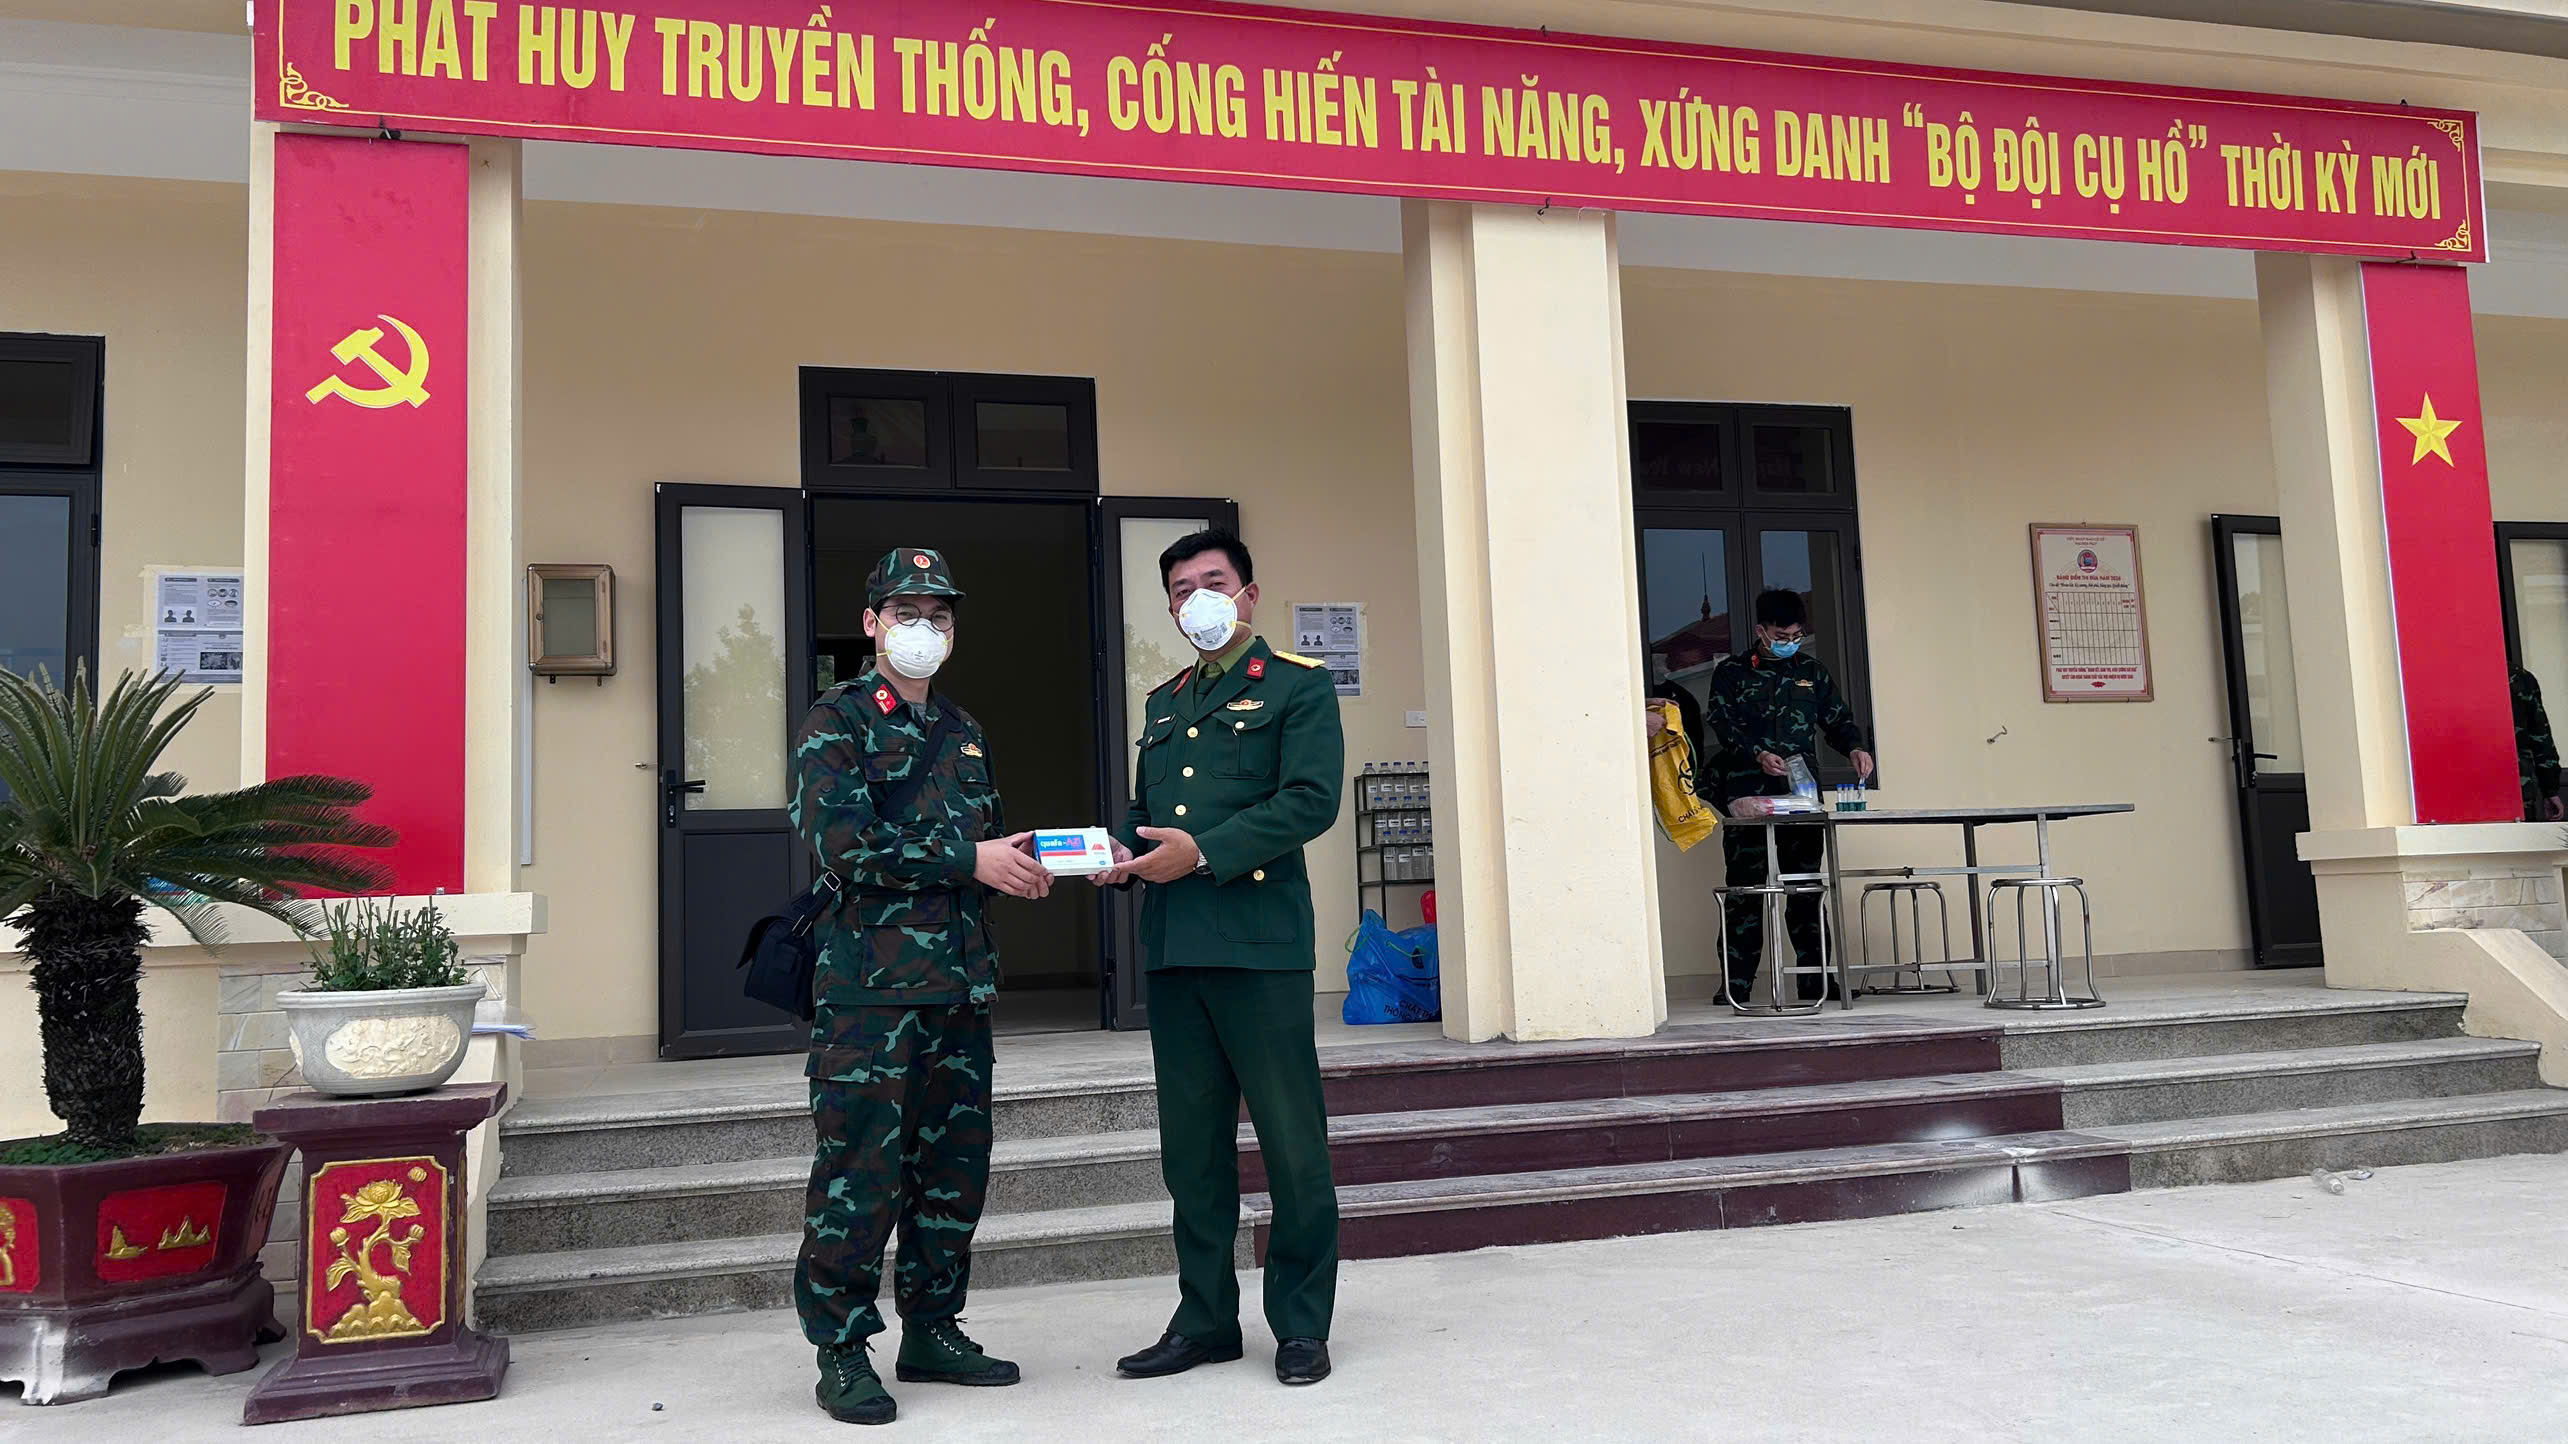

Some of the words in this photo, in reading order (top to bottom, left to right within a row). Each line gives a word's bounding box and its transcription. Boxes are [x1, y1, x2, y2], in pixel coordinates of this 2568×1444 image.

[519, 5, 635, 91] HUY
[655, 5, 875, 110] TRUYỀN
[894, 17, 1089, 137] THỐNG,
[1108, 33, 1247, 137] CỐNG
[1263, 50, 1377, 148] HIẾN
[1392, 66, 1465, 153] TÀI
[1483, 74, 1625, 173] NĂNG,
[1640, 86, 1761, 173] XỨNG
[1775, 111, 1889, 183] DANH
[1993, 116, 2060, 209] ĐỘI
[2074, 134, 2125, 214] CỤ
[2221, 133, 2305, 210] THỜI
[2316, 140, 2359, 214] KỲ
[2372, 145, 2441, 219] MỚI
